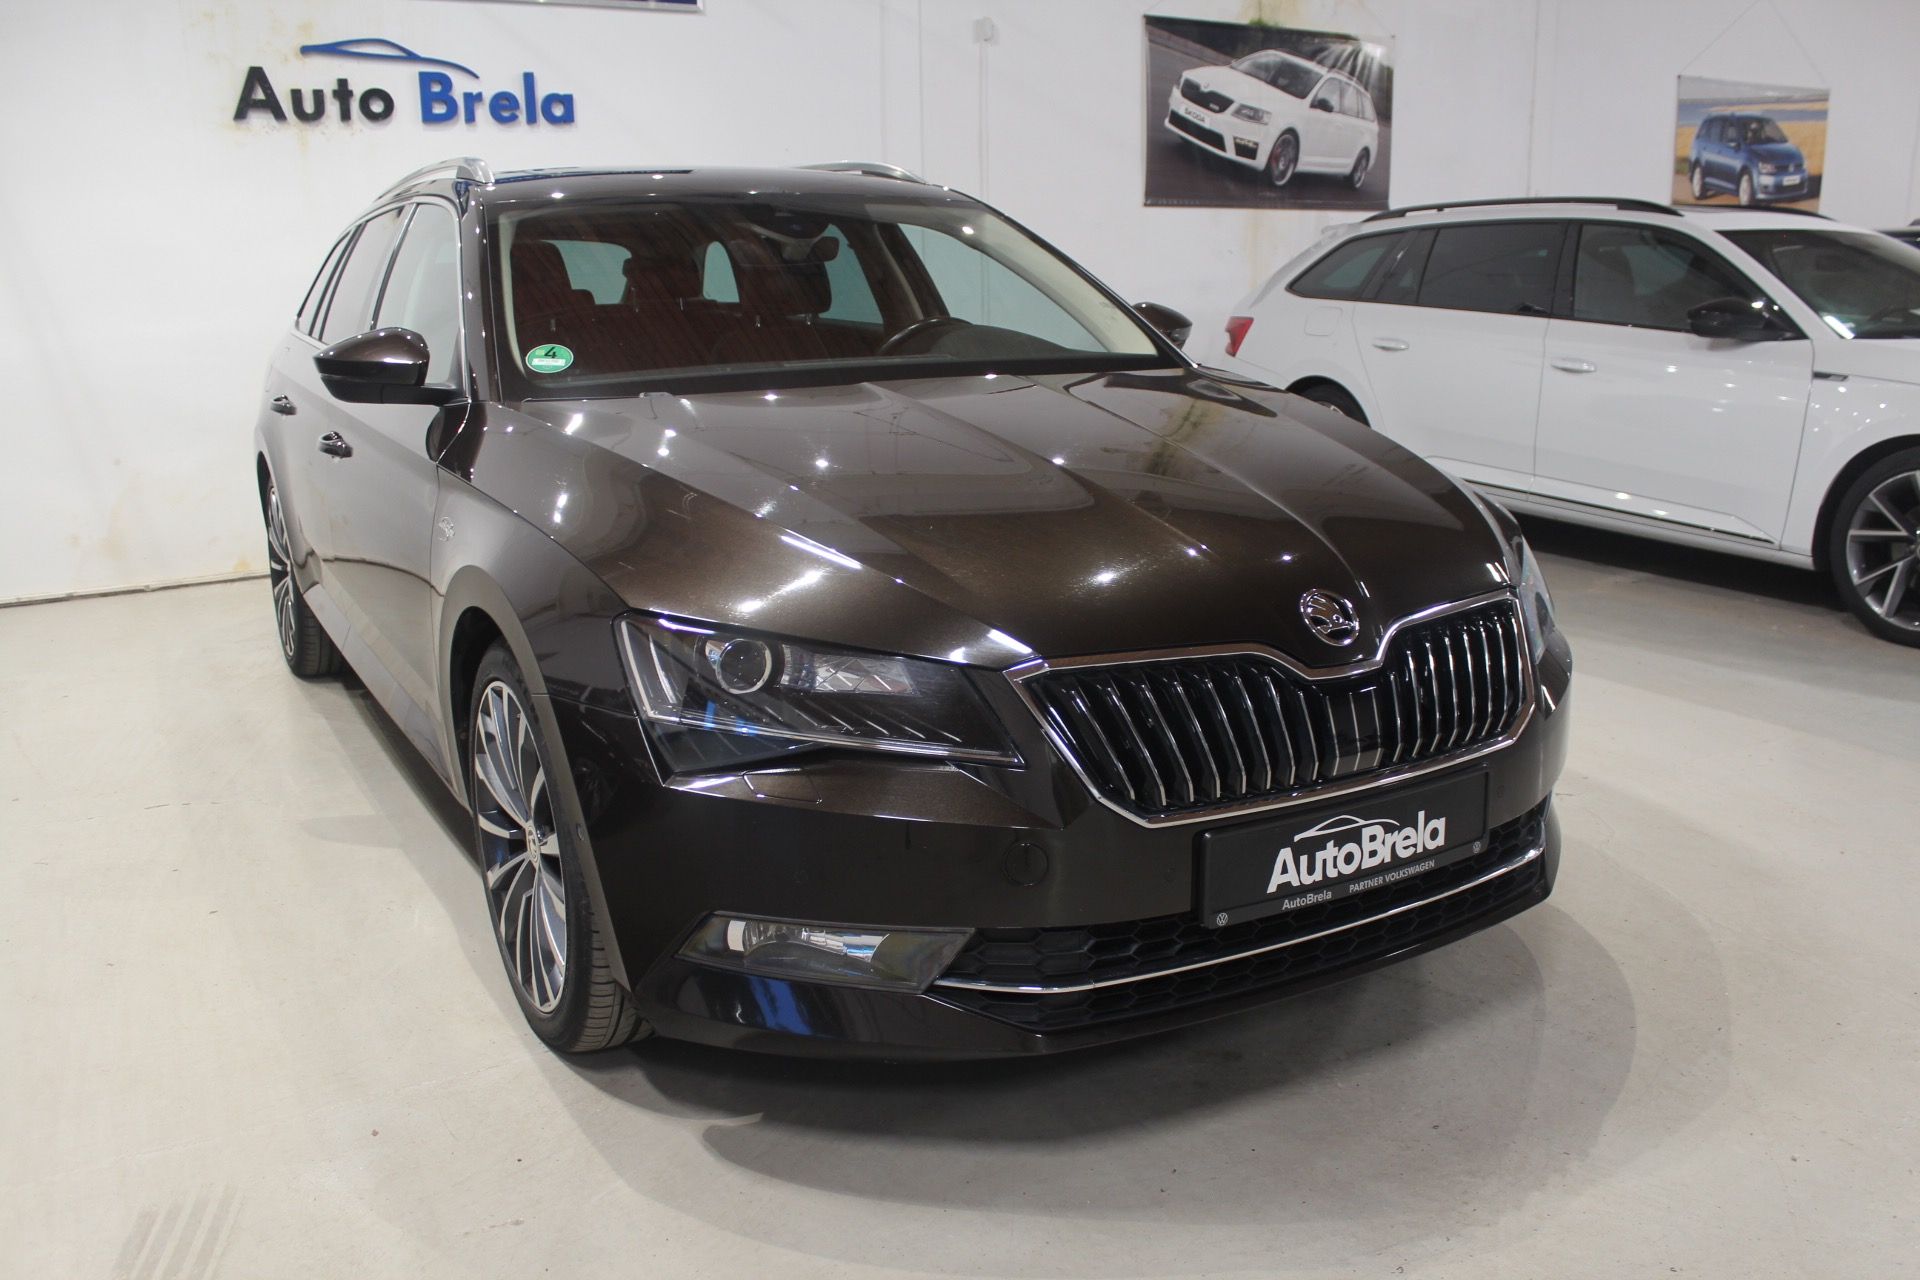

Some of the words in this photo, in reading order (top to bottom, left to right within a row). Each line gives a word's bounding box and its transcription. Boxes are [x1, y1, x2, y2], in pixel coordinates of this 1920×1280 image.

[233, 66, 395, 122] Auto
[418, 71, 575, 125] Brela
[544, 346, 557, 358] 4
[1266, 810, 1446, 894] AutoBrela
[1349, 874, 1384, 893] PARTNER
[1385, 859, 1435, 883] VOLKSWAGEN
[1282, 890, 1332, 910] AutoBrela
